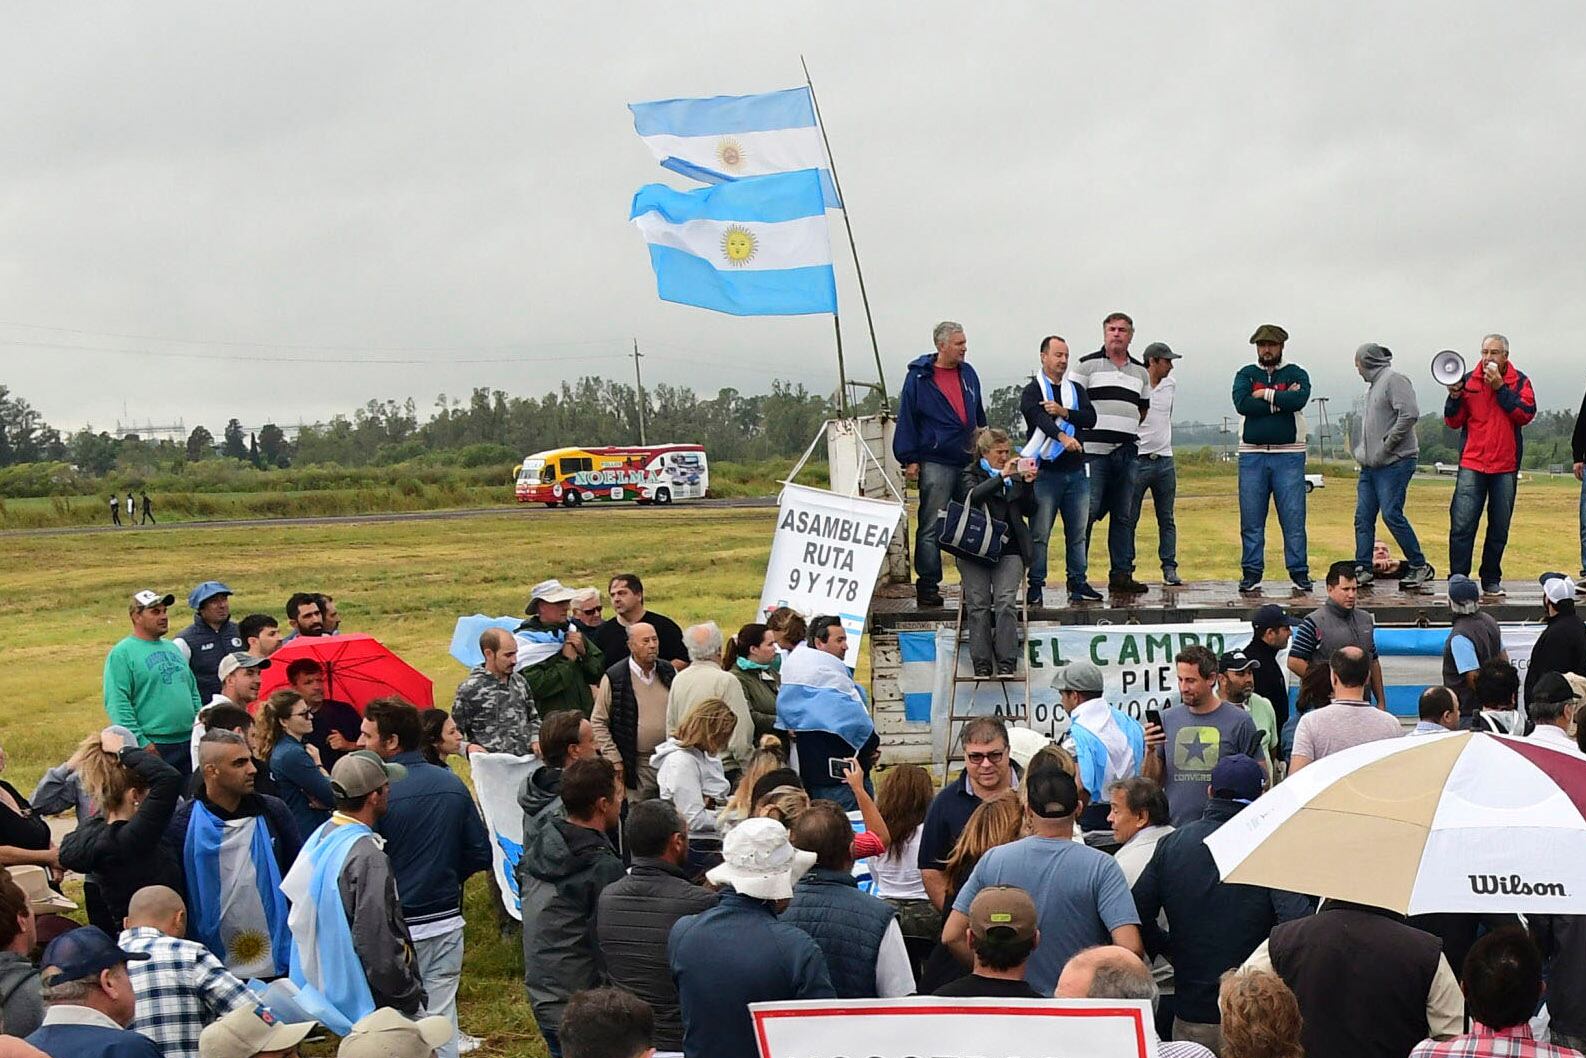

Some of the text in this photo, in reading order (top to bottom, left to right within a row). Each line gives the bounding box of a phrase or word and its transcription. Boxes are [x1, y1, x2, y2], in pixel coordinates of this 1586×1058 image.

[574, 470, 660, 486] NOELMA
[780, 508, 890, 549] ASAMBLEA
[803, 541, 854, 572] RUTA
[788, 568, 858, 602] 9 Y 178
[1028, 637, 1065, 668] EL
[1122, 667, 1171, 694] PIE
[1467, 874, 1567, 897] Wilson
